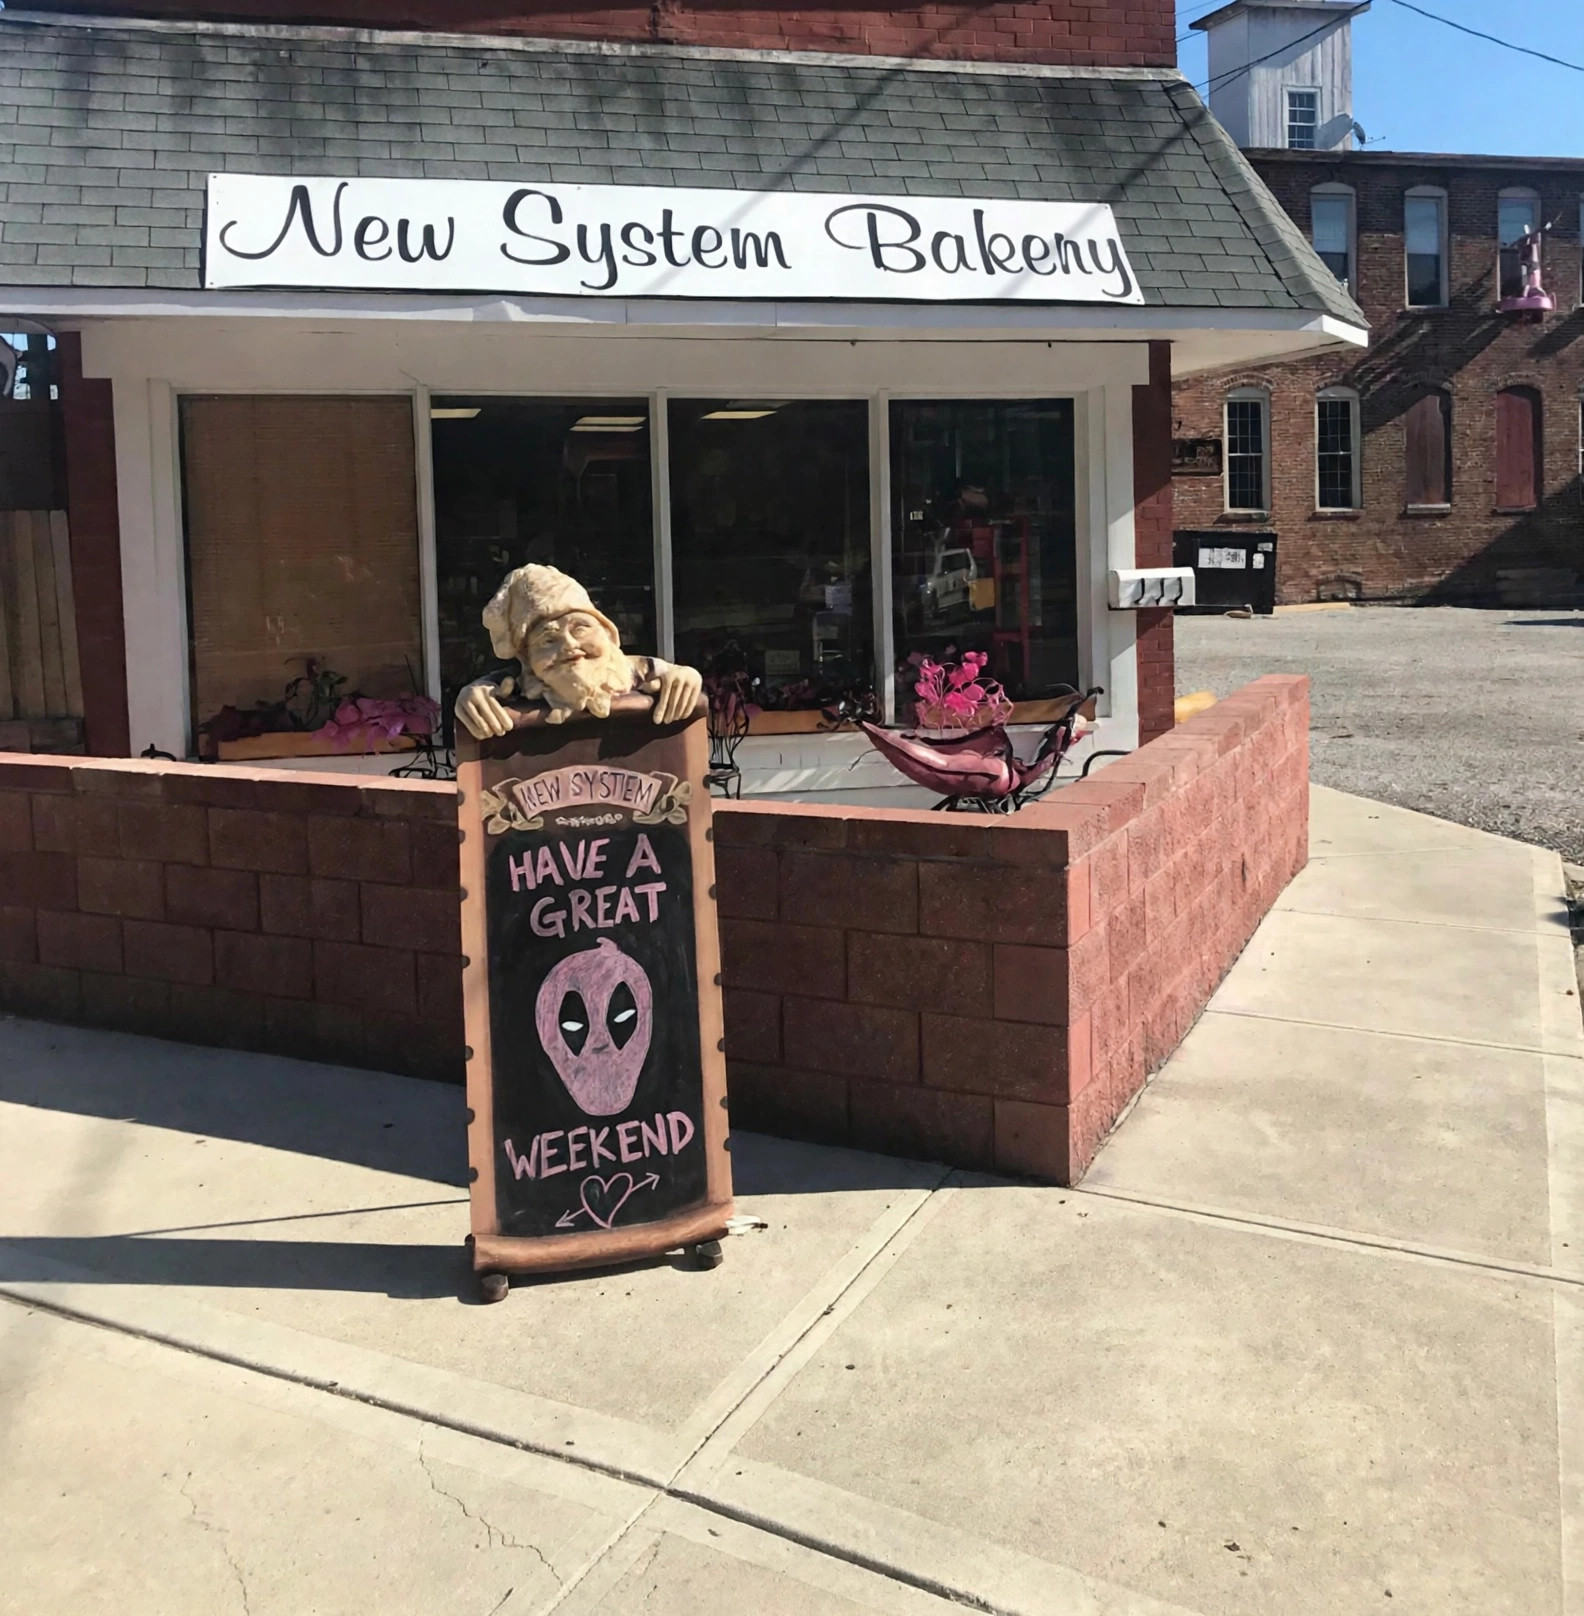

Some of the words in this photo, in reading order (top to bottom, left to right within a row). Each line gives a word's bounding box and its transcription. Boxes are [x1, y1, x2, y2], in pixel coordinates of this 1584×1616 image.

[219, 181, 455, 263] New
[500, 188, 793, 291] System
[824, 203, 1133, 298] Bakery
[519, 775, 560, 811] NEW
[570, 770, 654, 809] SYSTEM
[508, 837, 611, 892] HAVE
[625, 833, 662, 879] A
[529, 881, 667, 939] GREAT
[504, 1110, 695, 1179] WEEKEND
